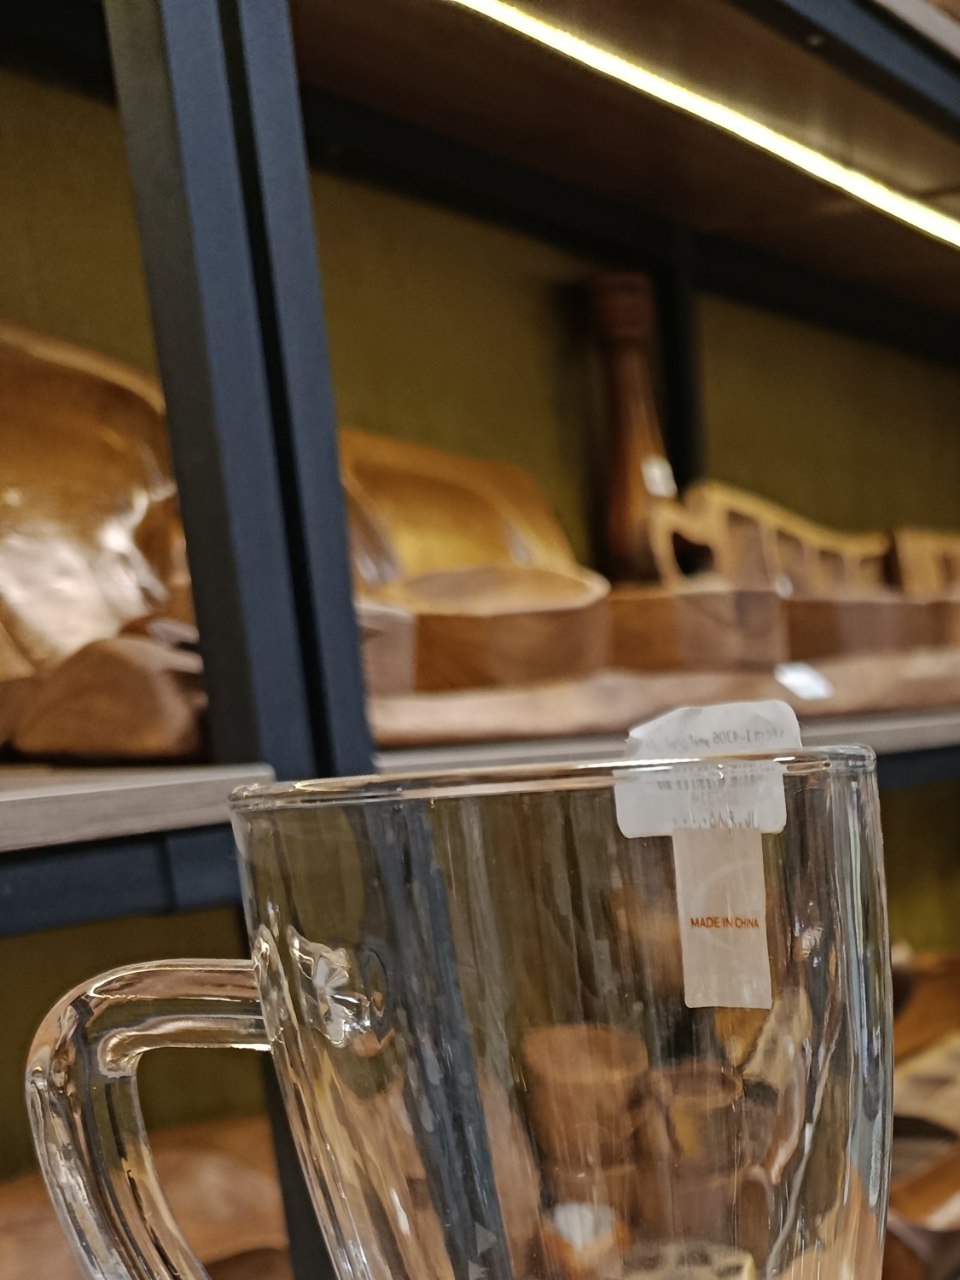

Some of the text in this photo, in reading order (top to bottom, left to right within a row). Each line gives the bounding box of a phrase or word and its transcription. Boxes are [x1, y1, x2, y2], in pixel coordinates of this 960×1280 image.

[690, 916, 760, 929] MADE IN CHINA
